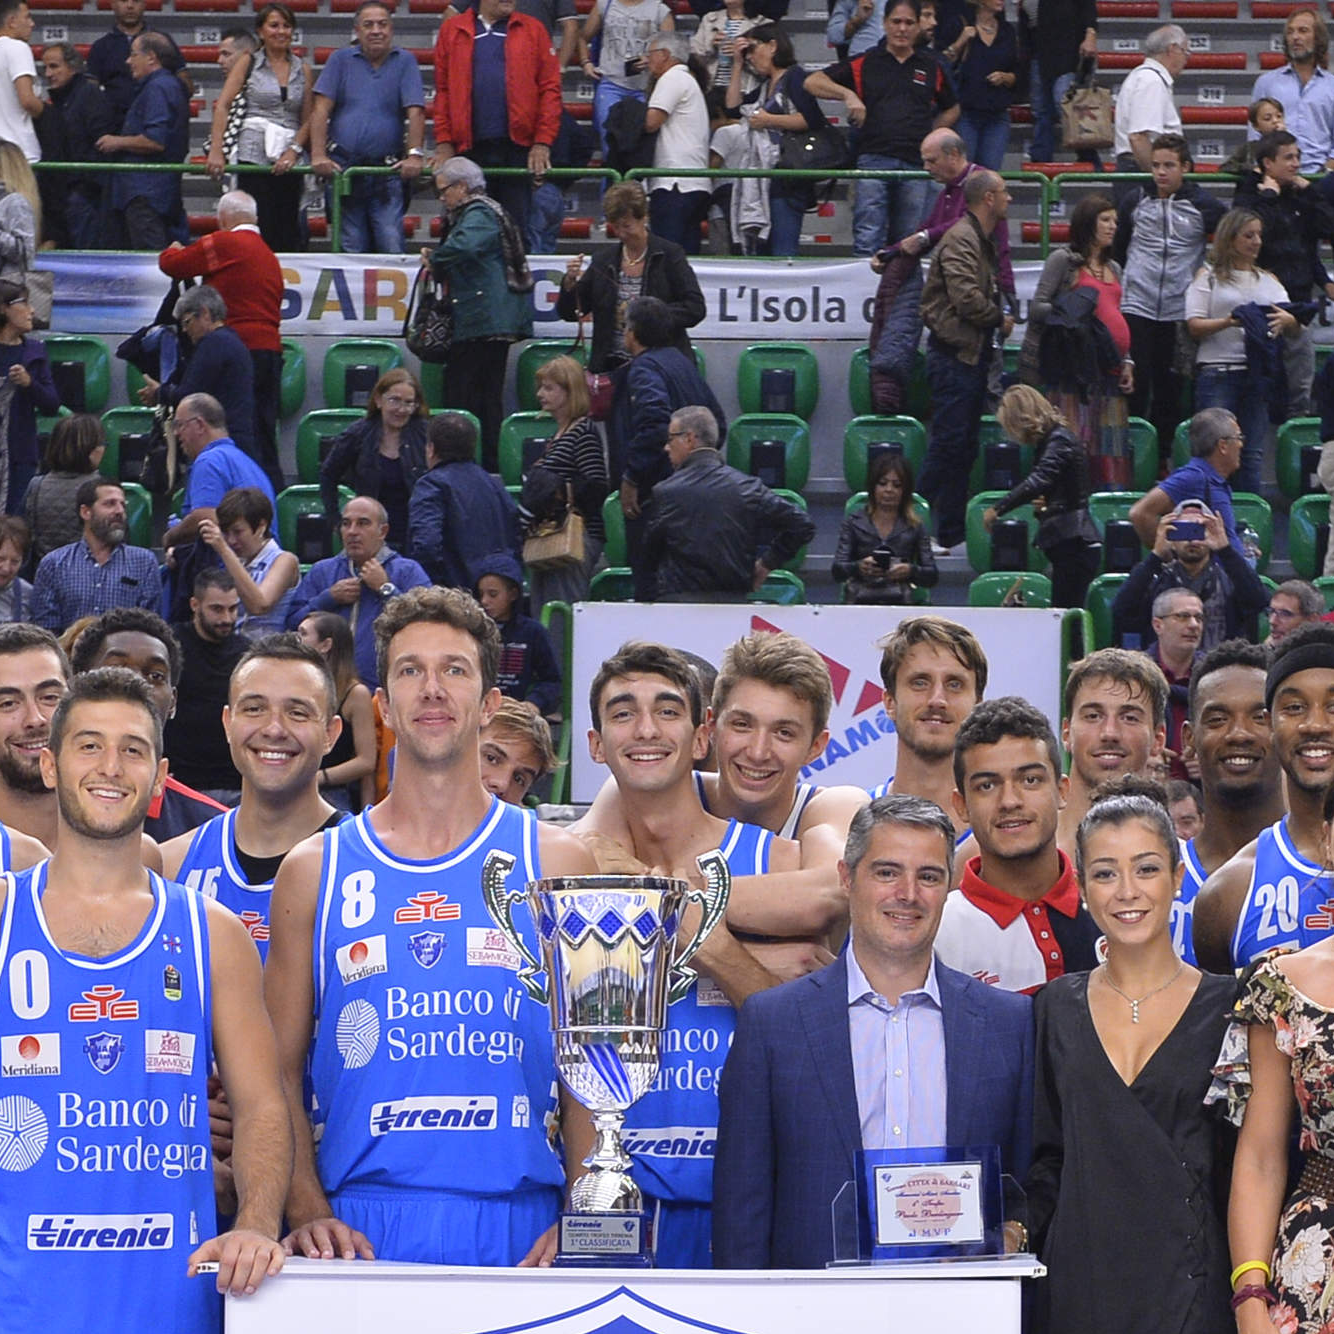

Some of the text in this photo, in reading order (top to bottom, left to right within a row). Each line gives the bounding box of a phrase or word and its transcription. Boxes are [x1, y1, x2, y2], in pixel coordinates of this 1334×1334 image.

[340, 870, 376, 928] 8
[1255, 876, 1298, 941] 20
[8, 949, 50, 1020] 0
[385, 987, 523, 1020] Banco di
[385, 1027, 525, 1064] Sardegna
[2, 1061, 60, 1076] Meridiana
[56, 1092, 197, 1129] Banco di
[56, 1134, 207, 1179] Sardegna
[30, 1217, 171, 1248] tirrenia
[579, 1239, 631, 1247] CLASSIFICATA
